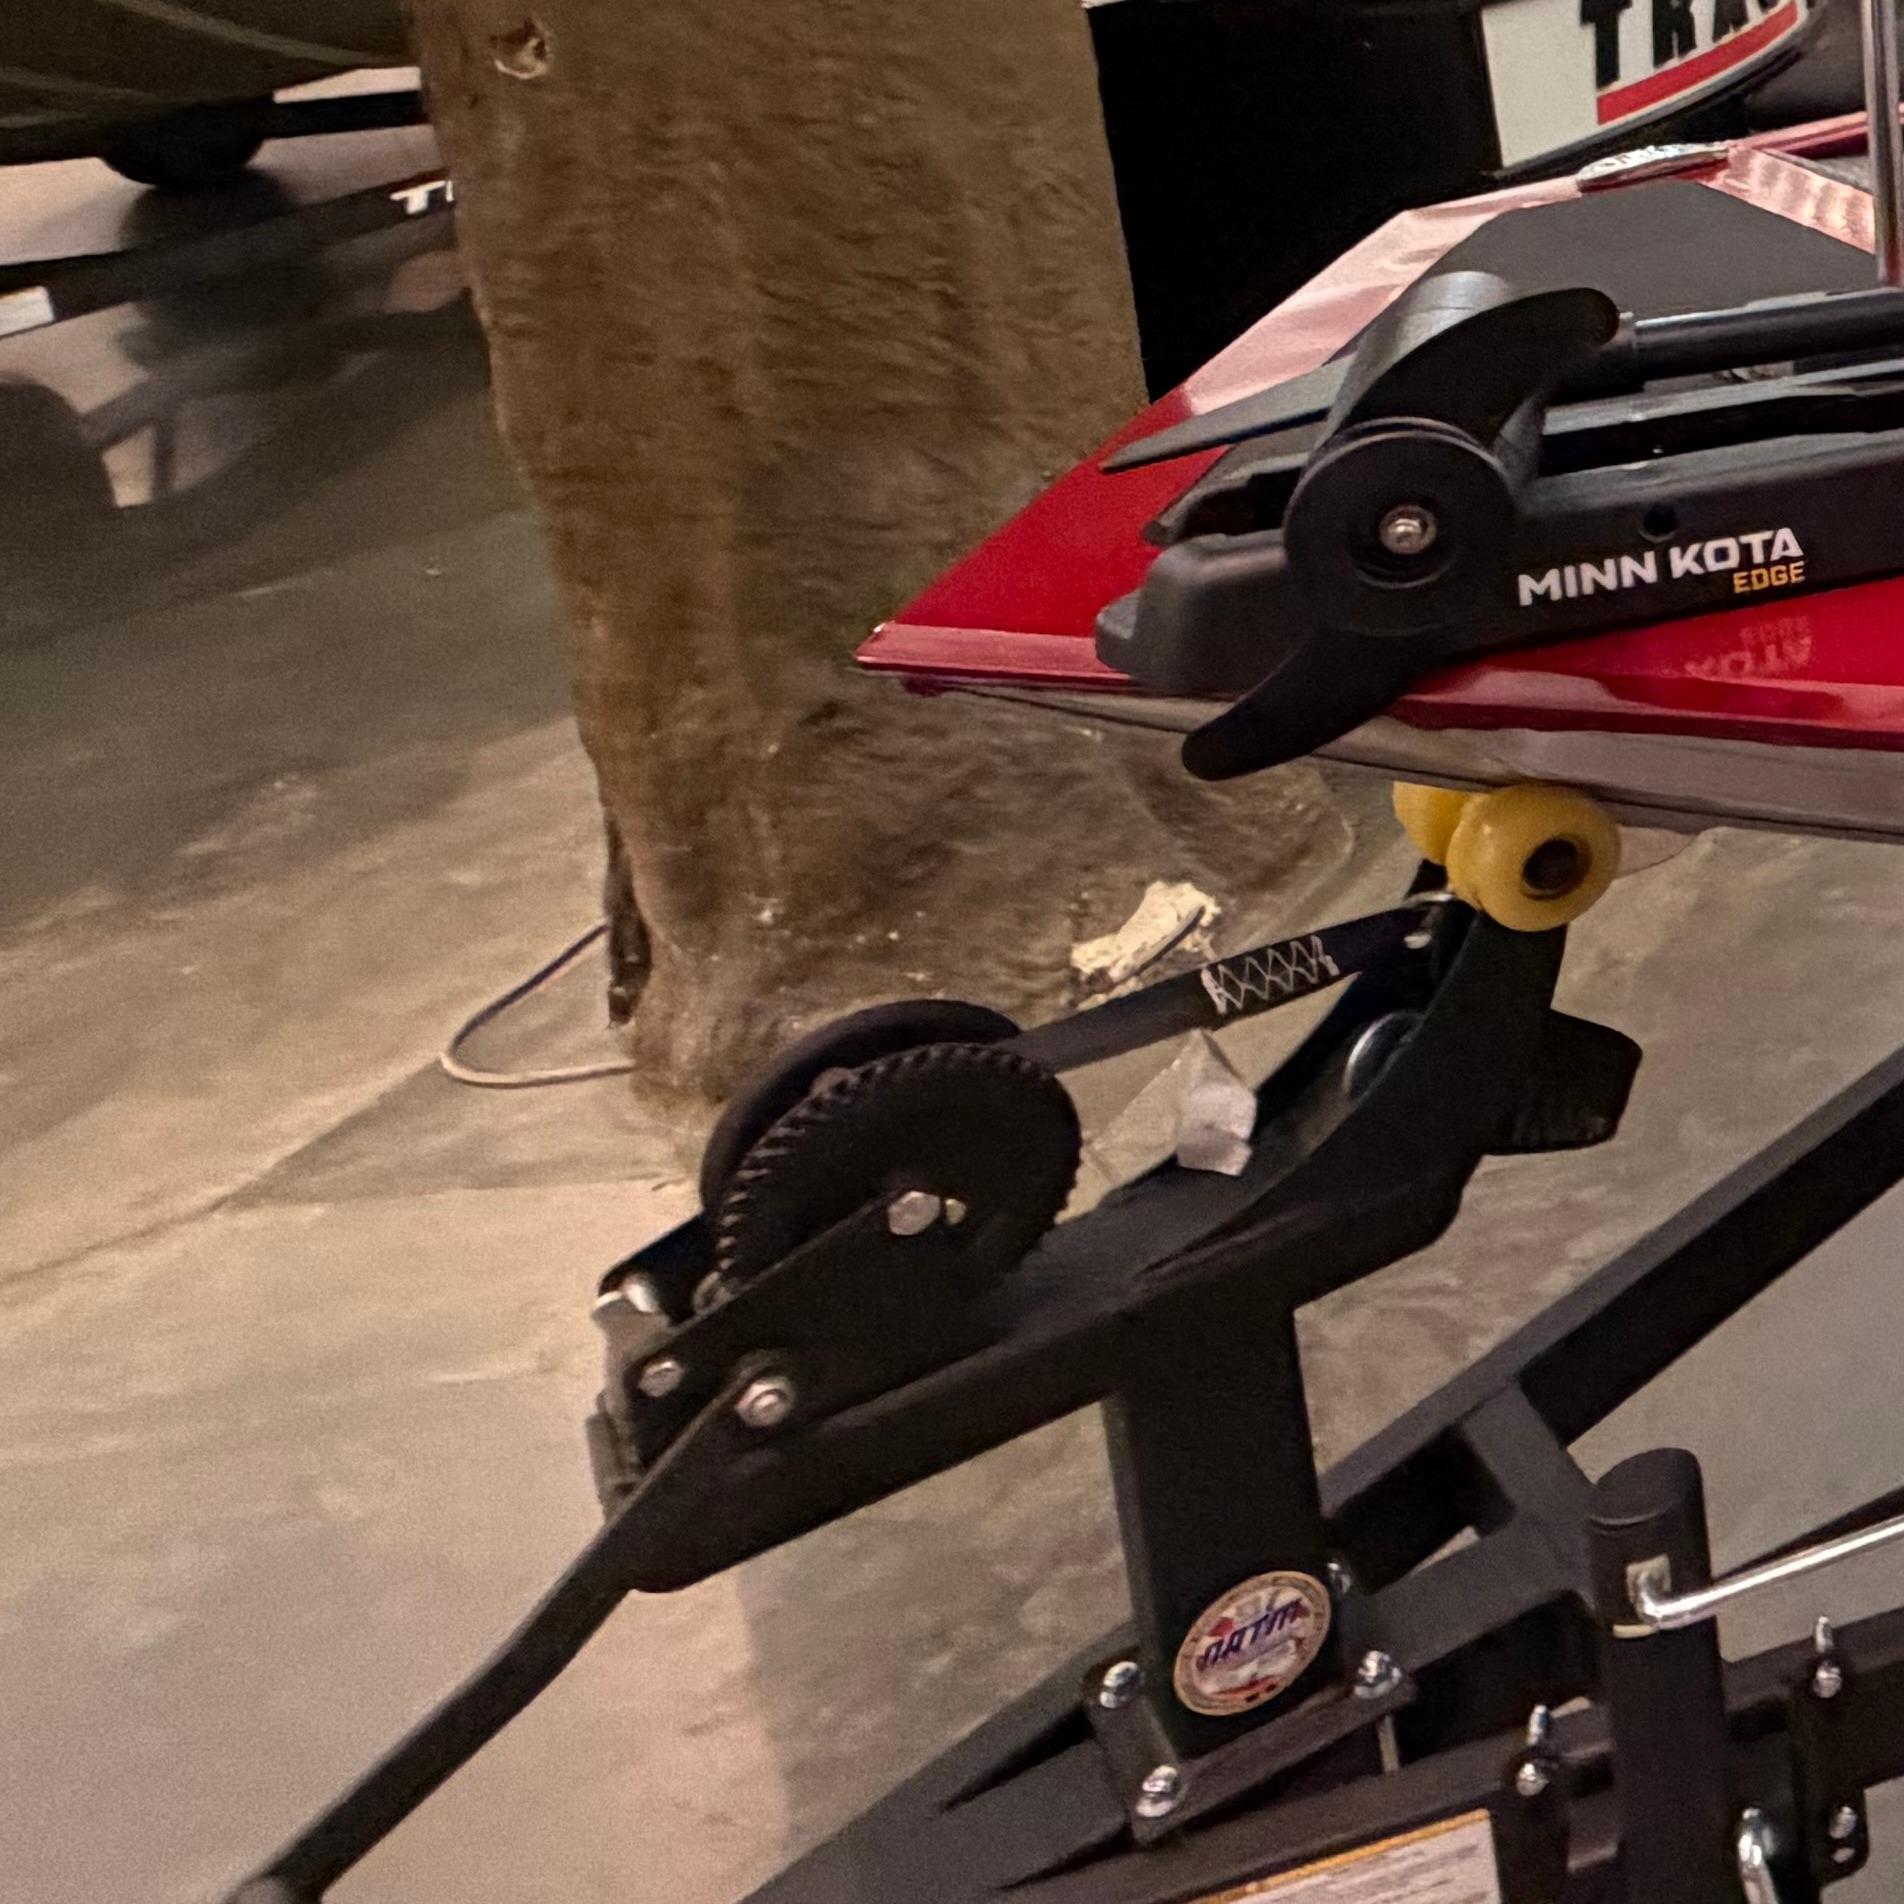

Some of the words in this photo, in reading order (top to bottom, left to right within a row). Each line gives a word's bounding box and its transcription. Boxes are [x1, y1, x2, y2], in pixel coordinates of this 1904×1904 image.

[1518, 550, 1658, 607] MINN
[1669, 527, 1804, 579] KOTA
[1733, 561, 1806, 594] EDGE
